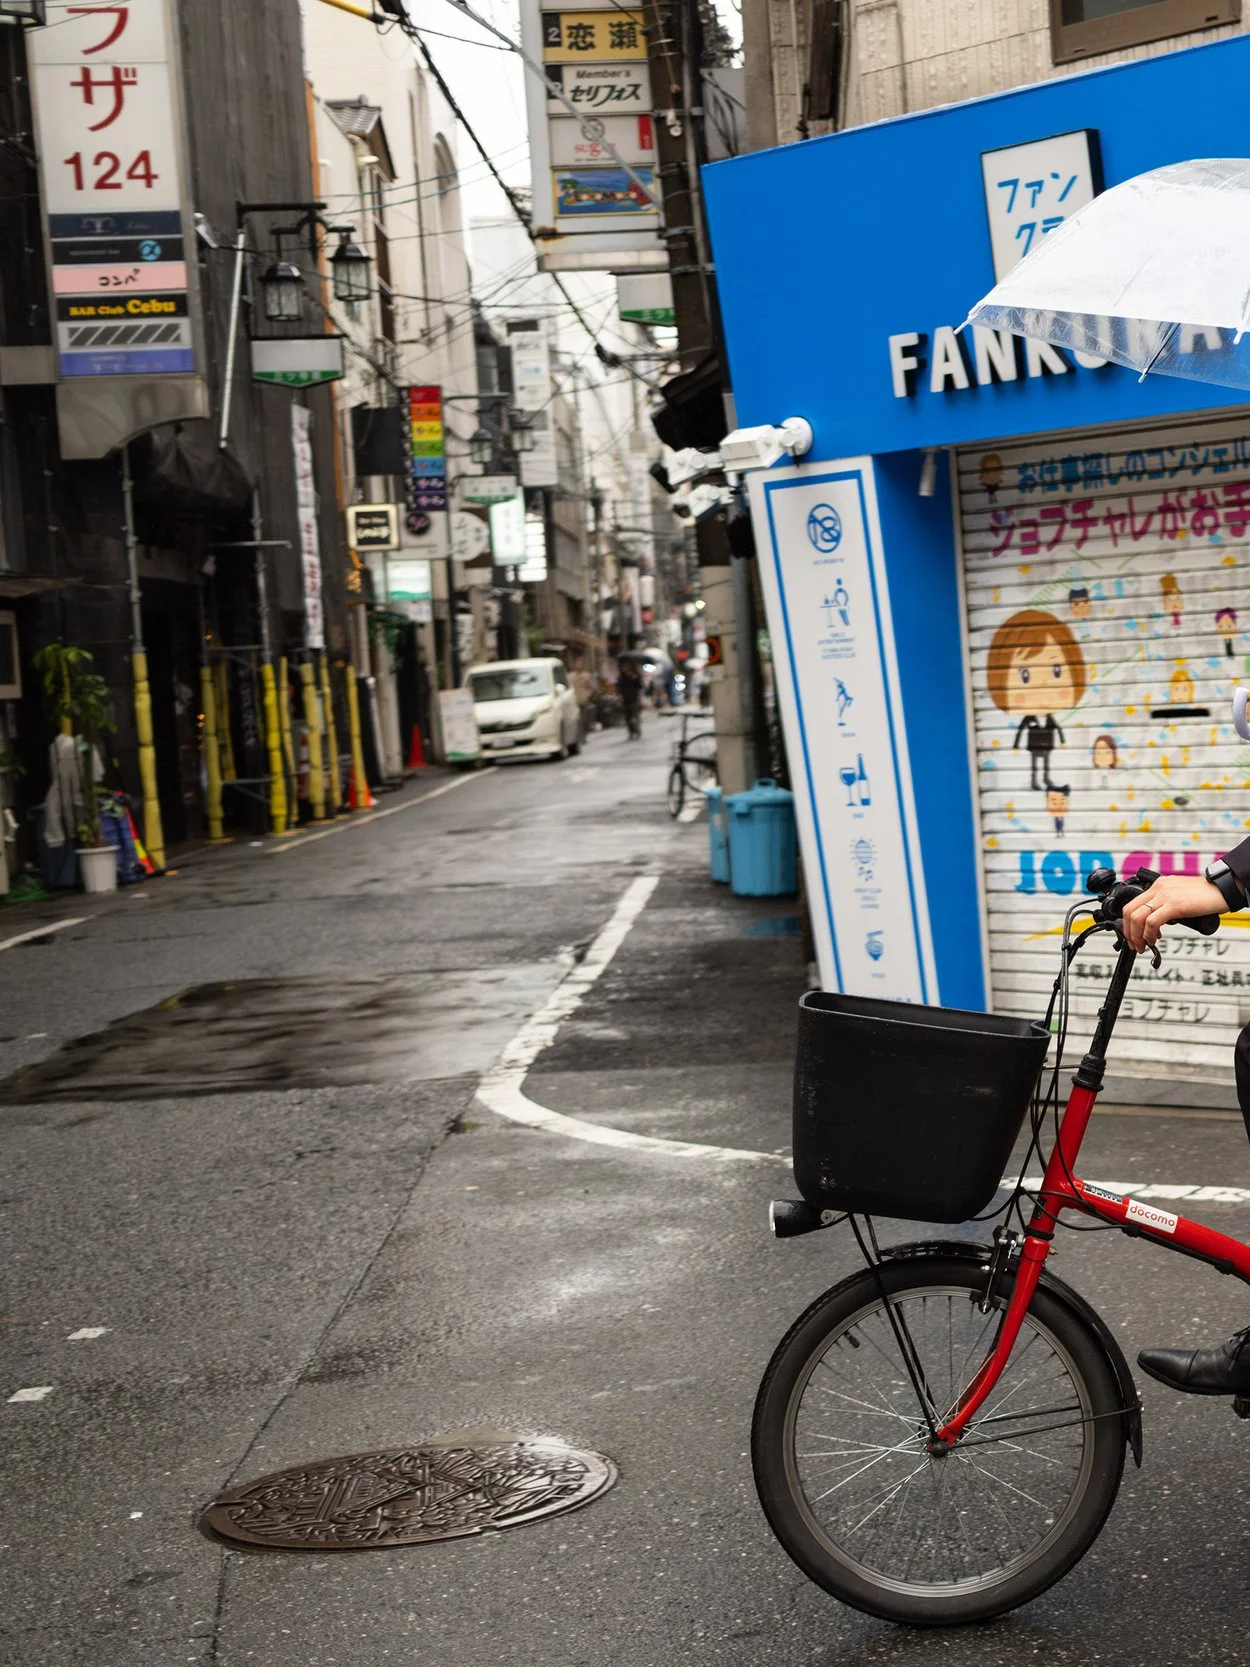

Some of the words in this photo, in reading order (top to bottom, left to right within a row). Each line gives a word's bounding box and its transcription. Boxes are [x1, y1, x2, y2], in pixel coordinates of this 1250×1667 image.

[548, 27, 559, 41] 2
[576, 70, 632, 78] Member's
[570, 84, 642, 107] セリフォス
[63, 150, 159, 191] 124
[997, 172, 1079, 213] ファン
[126, 299, 176, 313] Cebu
[1130, 1205, 1176, 1227] docomo
